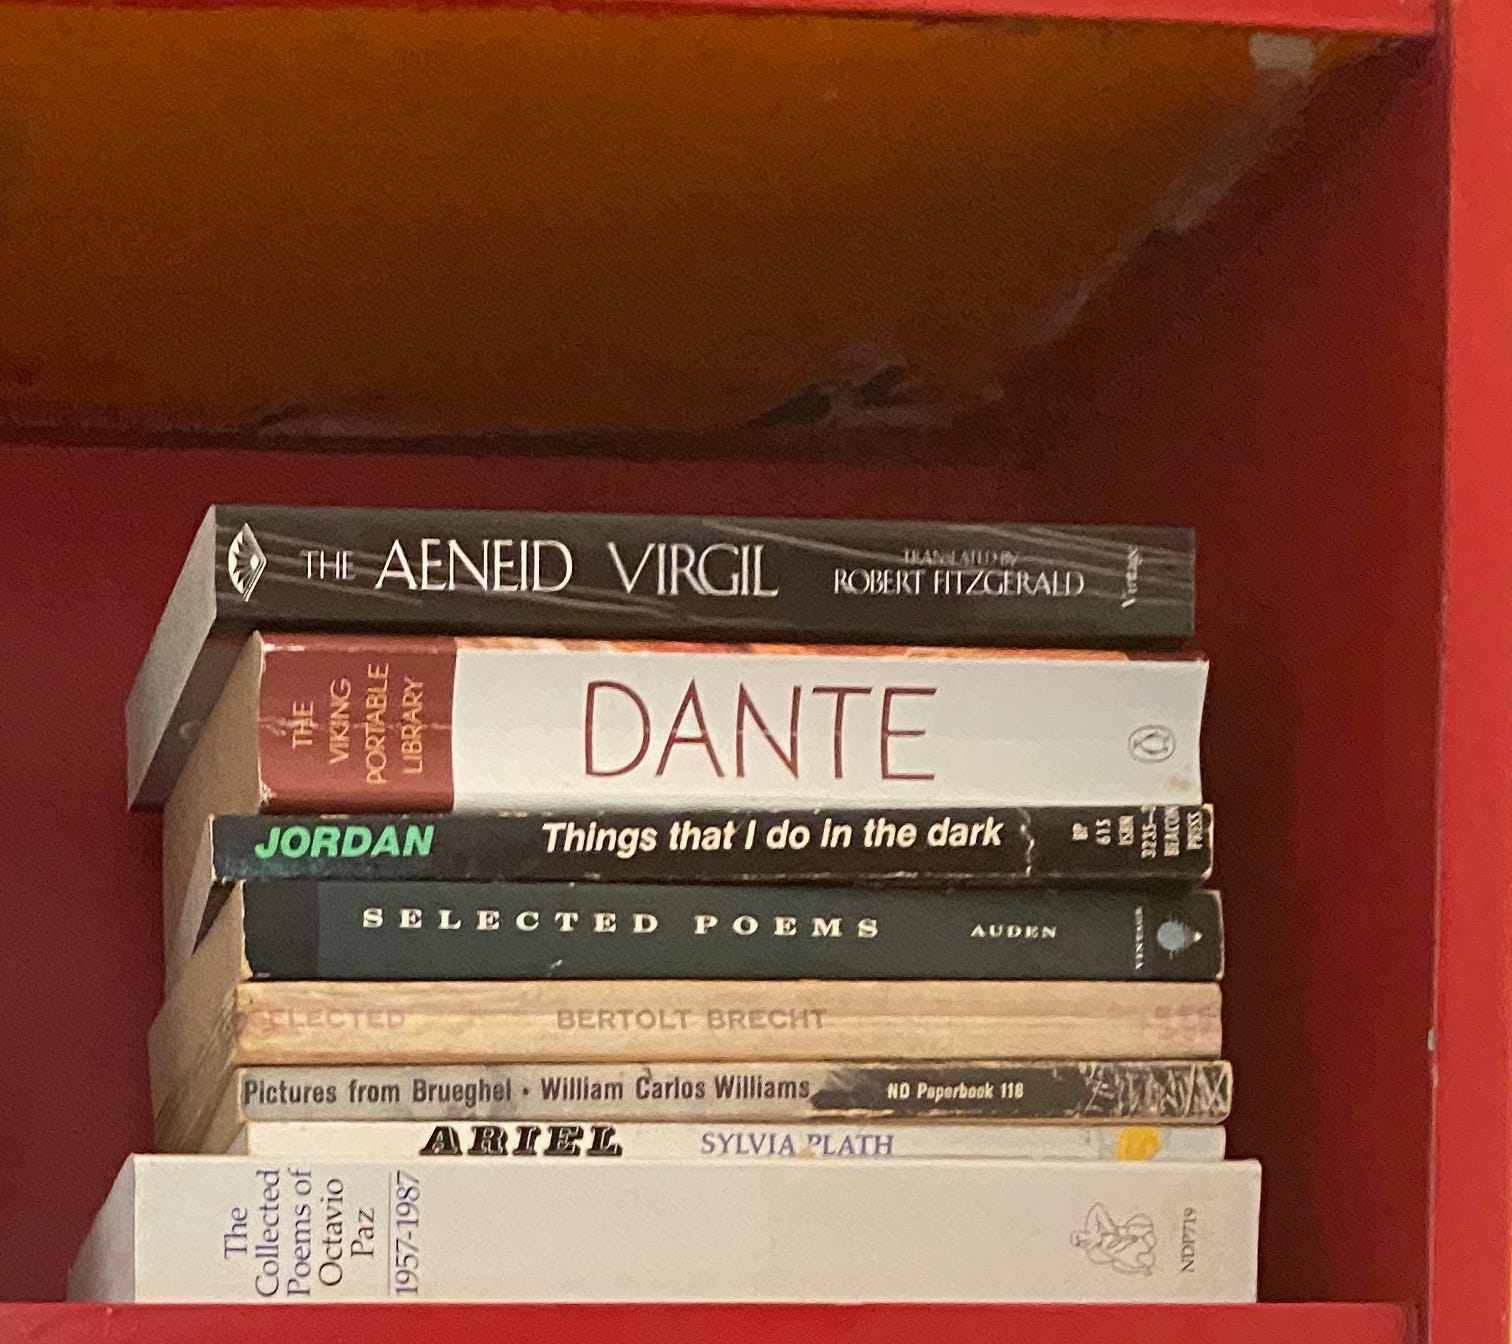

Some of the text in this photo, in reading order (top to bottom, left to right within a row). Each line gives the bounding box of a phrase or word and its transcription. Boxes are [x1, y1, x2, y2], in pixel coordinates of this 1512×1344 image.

[303, 538, 778, 597] THE AENEID VIRGIL
[834, 570, 1085, 597] ROBERT FITZGERALD
[292, 700, 314, 749] THE
[329, 677, 351, 765] VIKING
[366, 663, 389, 785] PORTABLE
[402, 678, 423, 774] LIBRARY
[586, 678, 937, 781] DANTE
[255, 825, 434, 857] JORDAN
[542, 822, 657, 857] Things
[670, 821, 733, 850] that
[745, 822, 756, 848] I
[767, 819, 810, 848] do
[864, 817, 916, 847] the
[928, 817, 1004, 847] dark
[362, 908, 878, 938] SELECTED POEMS
[244, 1075, 810, 1108] Pictures from Brueghel William Carlos Williams
[420, 1126, 624, 1156] ARIEL
[225, 1207, 248, 1259] The
[256, 1168, 279, 1298] Collected
[286, 1168, 311, 1297] Poems of
[319, 1178, 343, 1287] Octavio
[351, 1208, 375, 1259] Paz
[395, 1169, 420, 1296] 1957-1987
